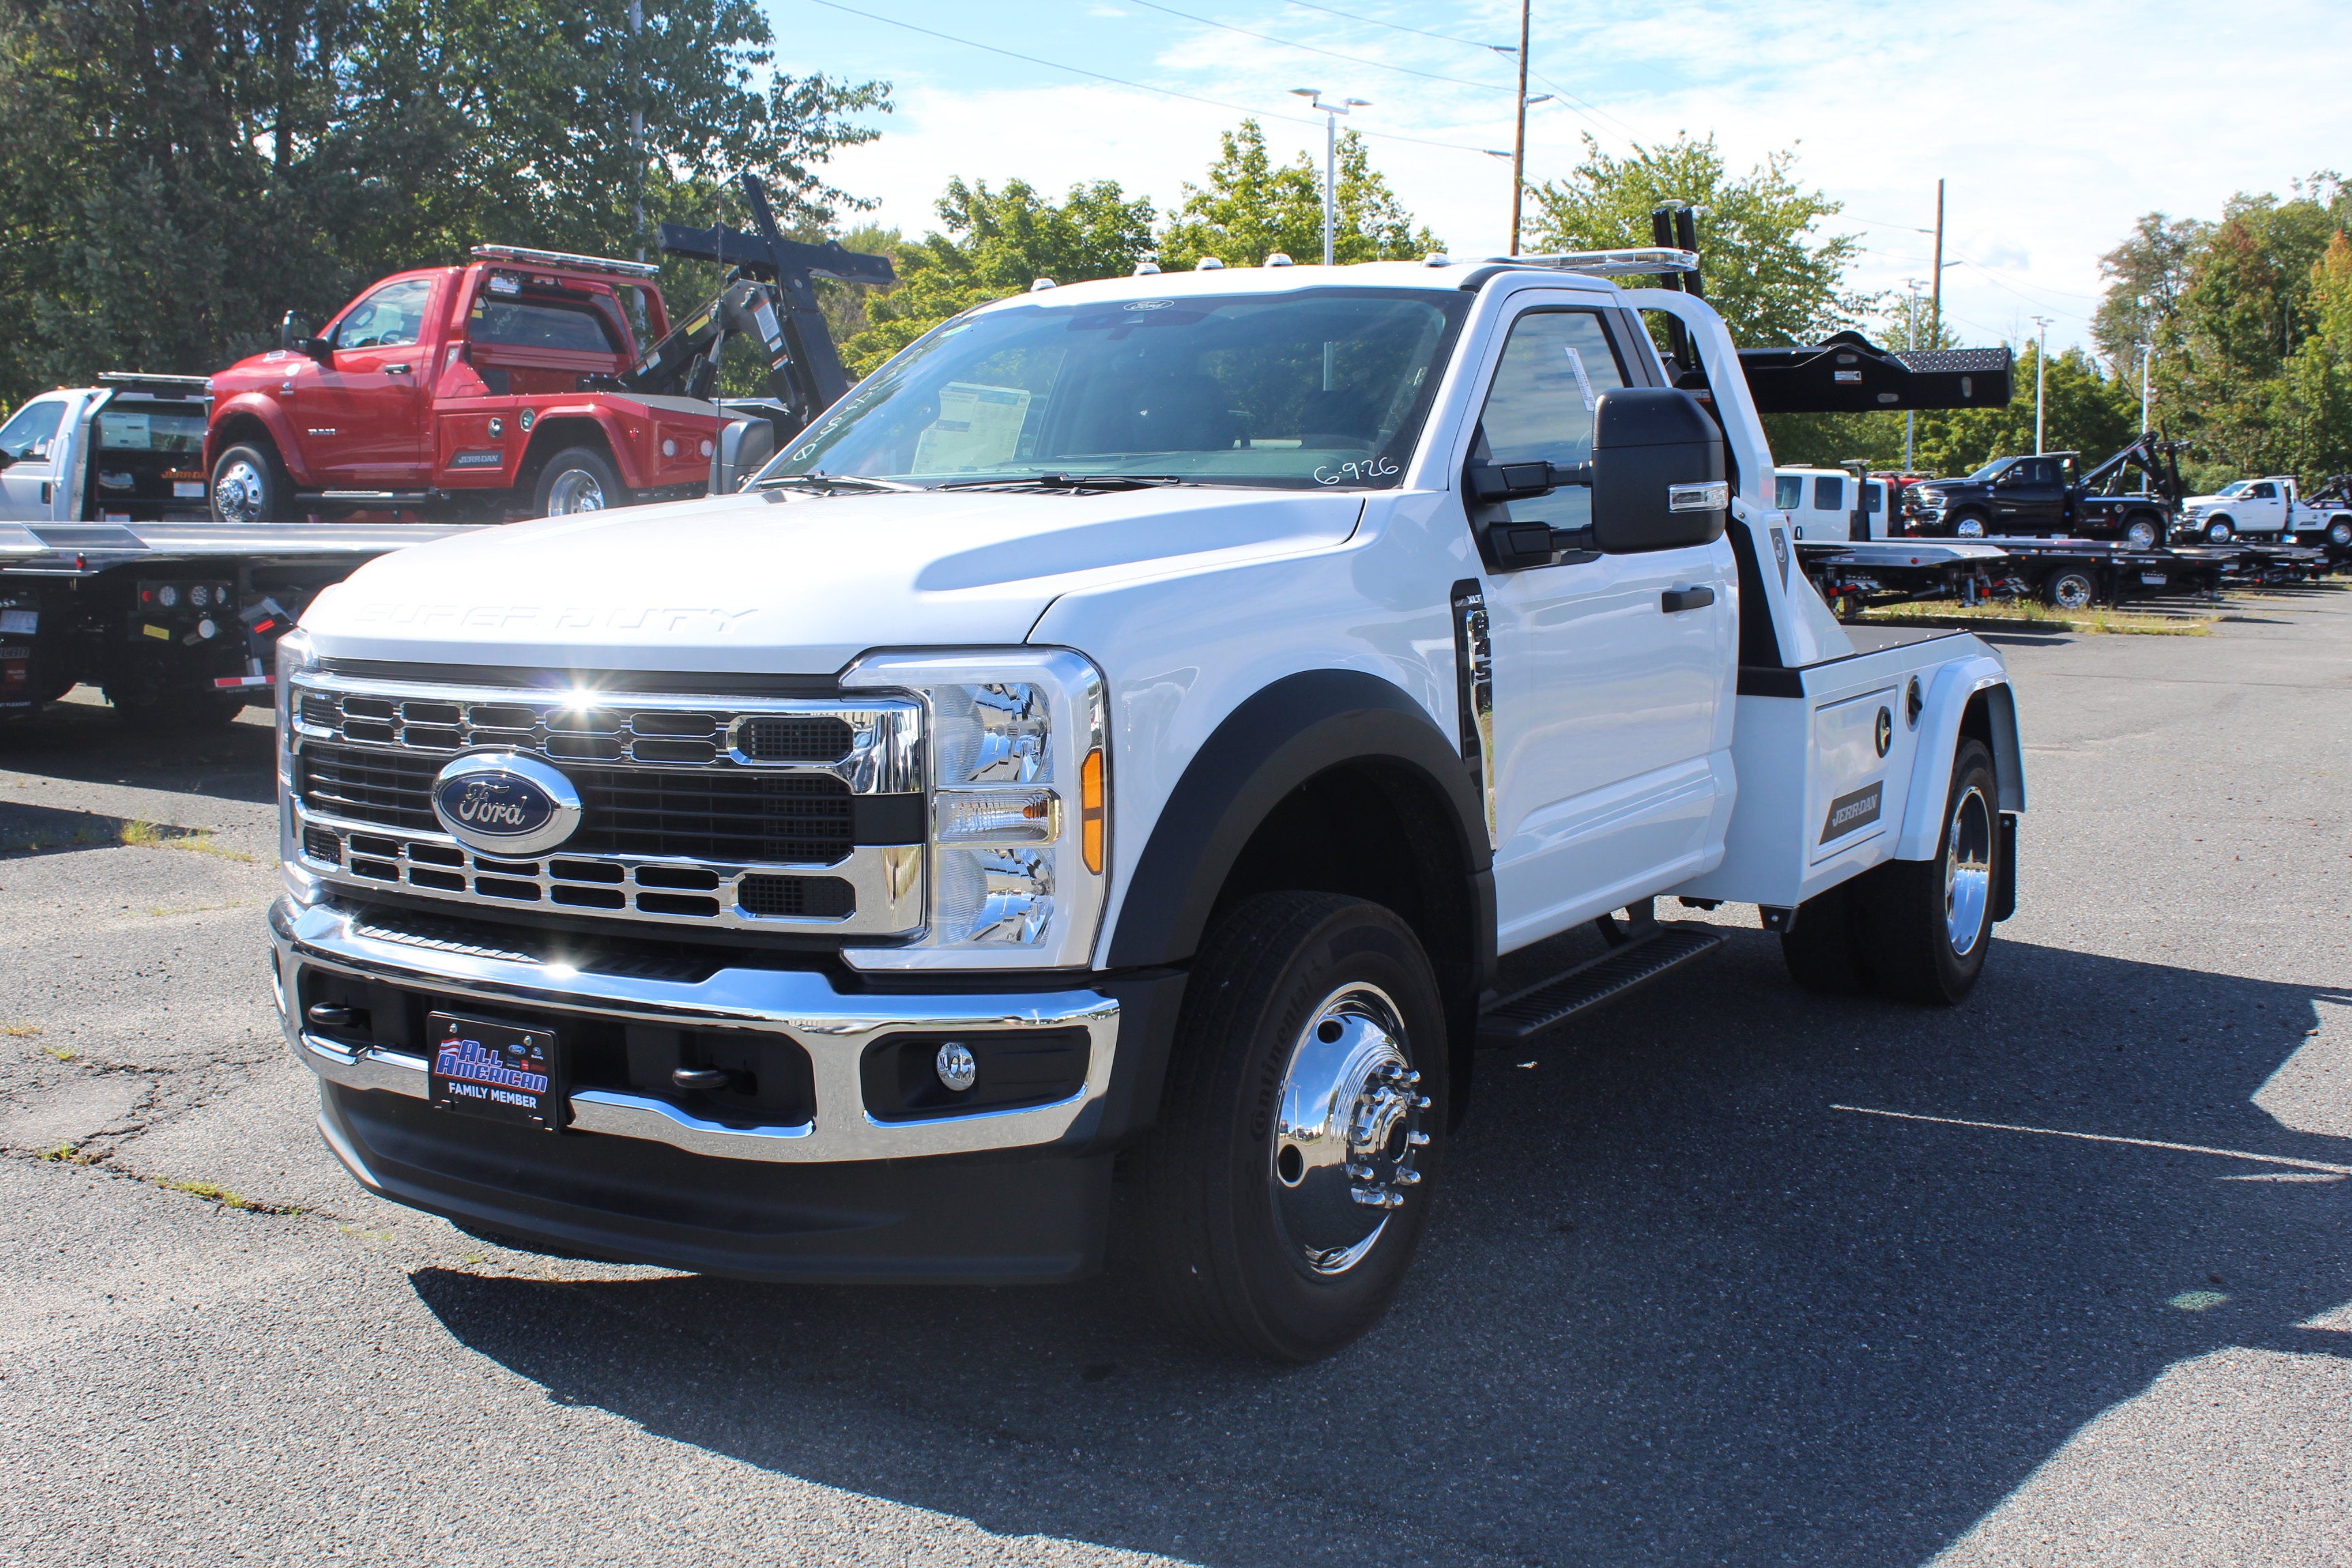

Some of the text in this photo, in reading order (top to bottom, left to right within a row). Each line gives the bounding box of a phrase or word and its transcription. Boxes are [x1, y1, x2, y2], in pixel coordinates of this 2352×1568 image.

[1466, 594, 1482, 604] XLT
[459, 781, 527, 825] Ford
[458, 1039, 504, 1068] ALL
[435, 1052, 549, 1093] AMERICAN
[448, 1081, 538, 1109] FAMILY MEMBER
